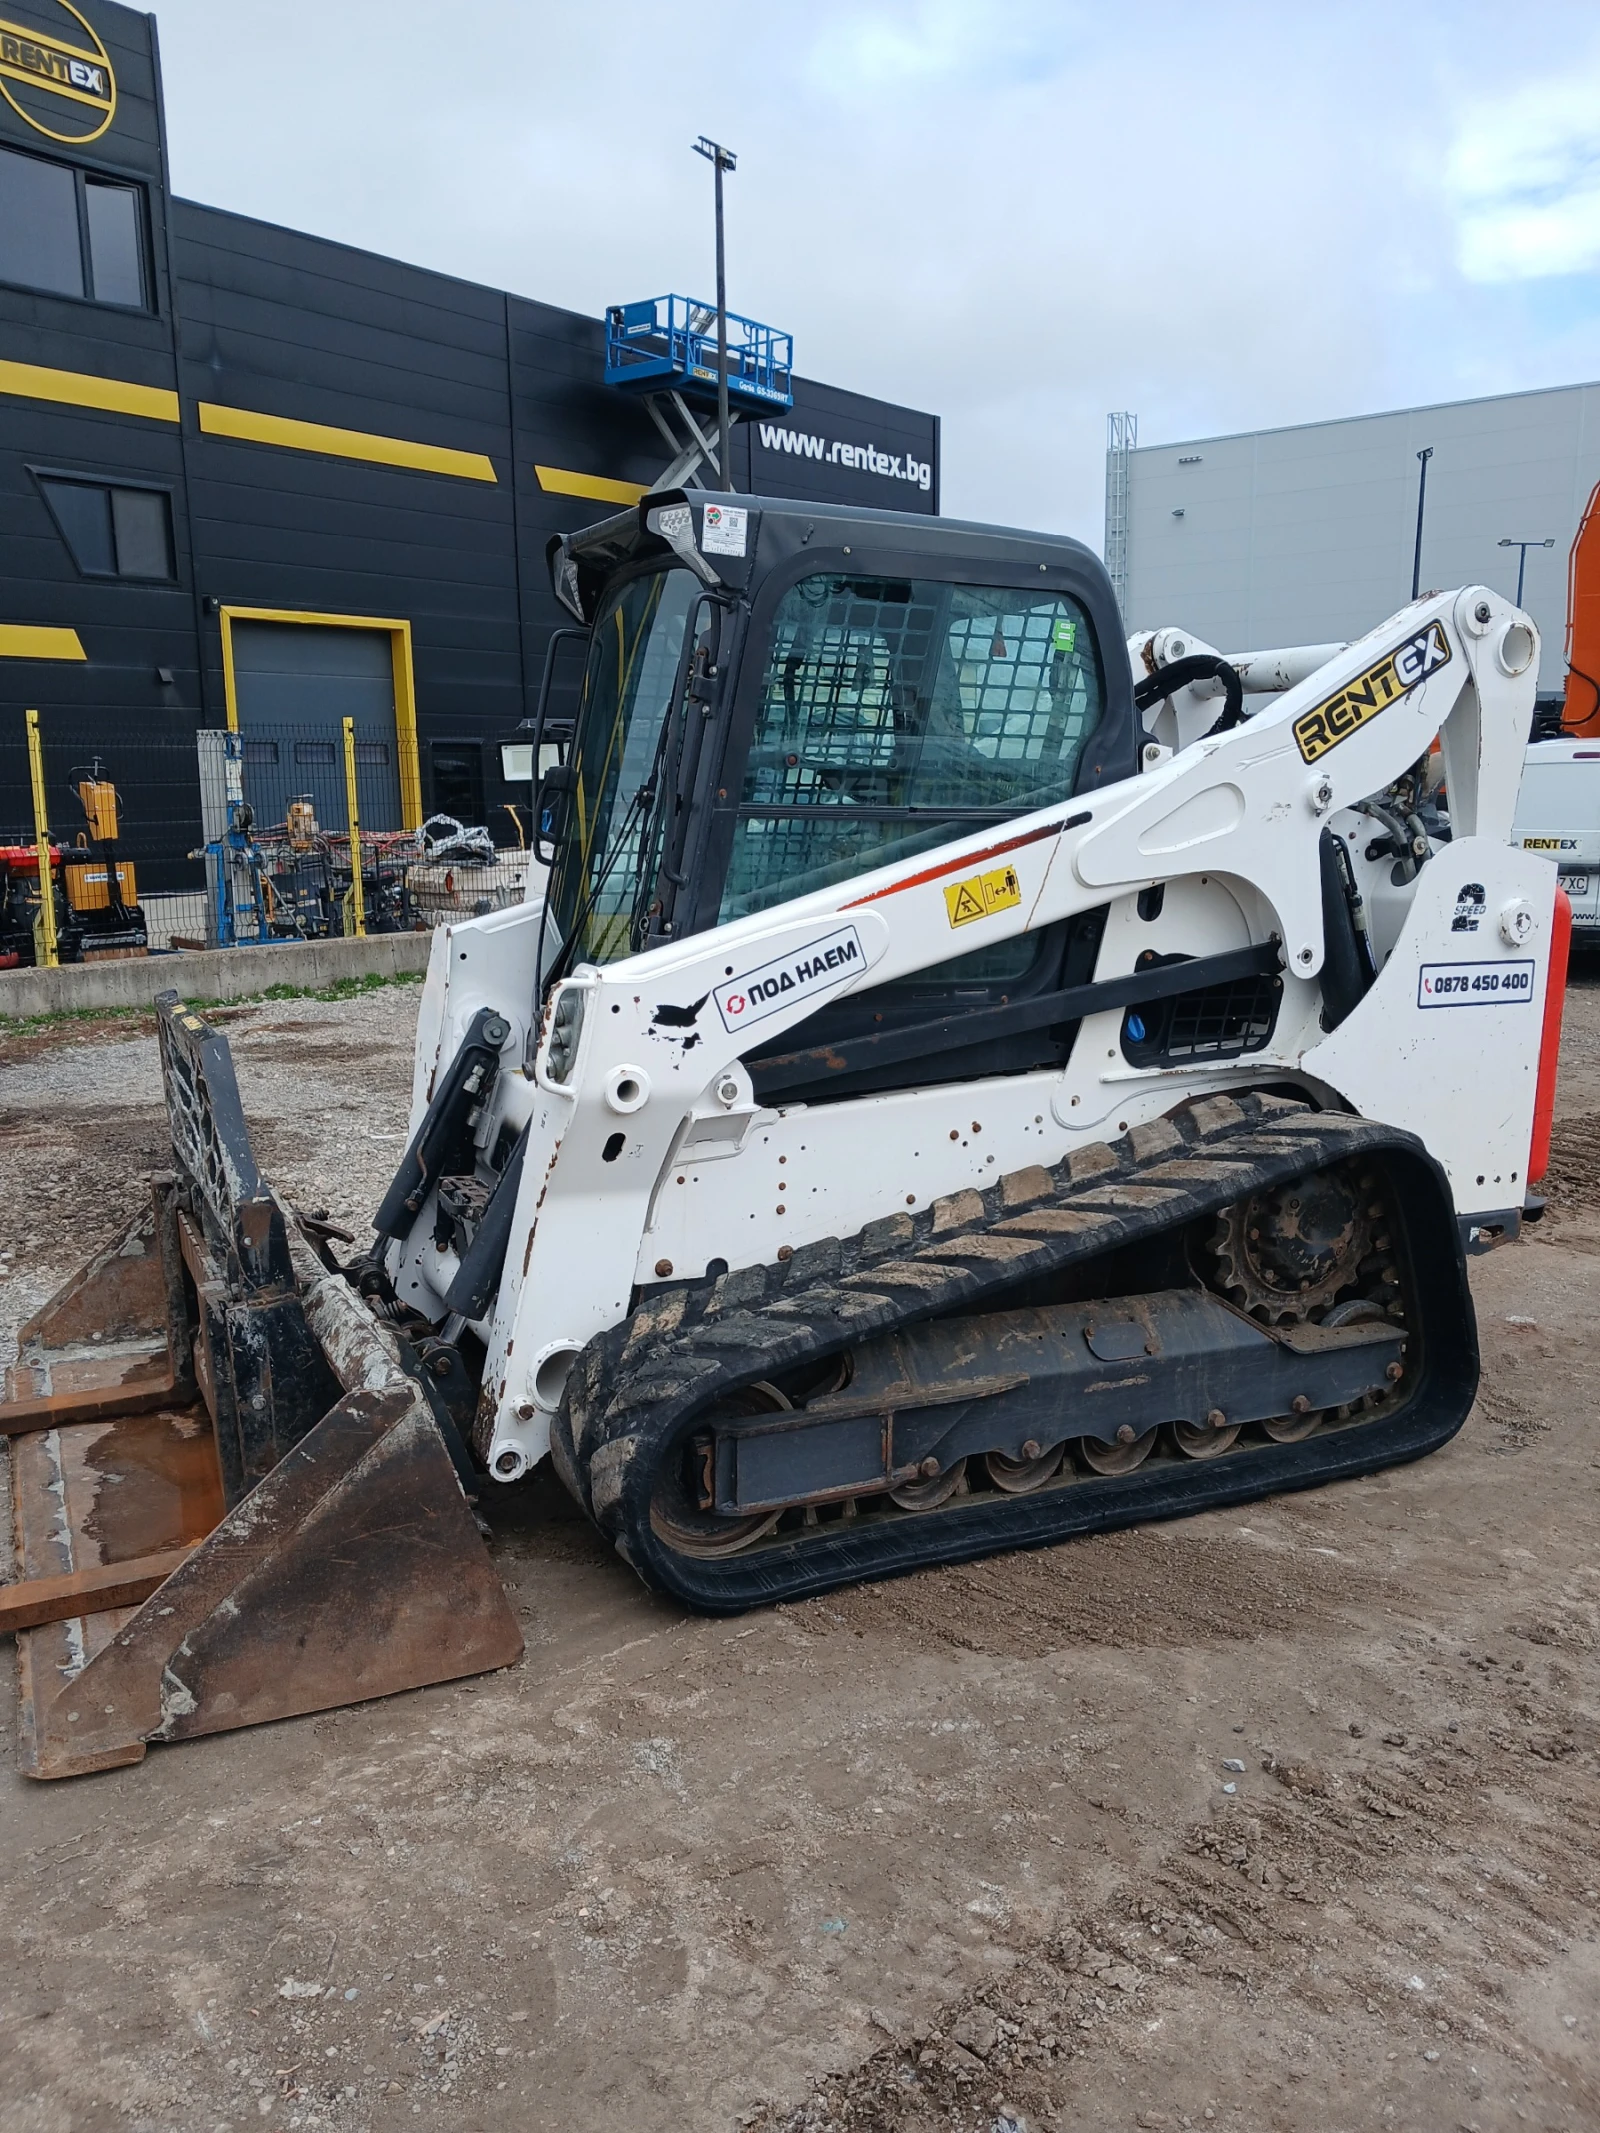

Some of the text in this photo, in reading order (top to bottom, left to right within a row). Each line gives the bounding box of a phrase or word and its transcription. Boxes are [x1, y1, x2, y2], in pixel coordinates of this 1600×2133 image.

[1, 35, 102, 92] RENTEX
[759, 423, 931, 491] www.rentex.bg
[1299, 627, 1446, 757] RENTEX
[1523, 838, 1579, 850] RENTEX
[1568, 877, 1585, 890] XC
[1454, 905, 1487, 916] SPEED
[747, 940, 858, 1006] ПОД НАЕМ
[1434, 973, 1529, 994] 0878 450 400
